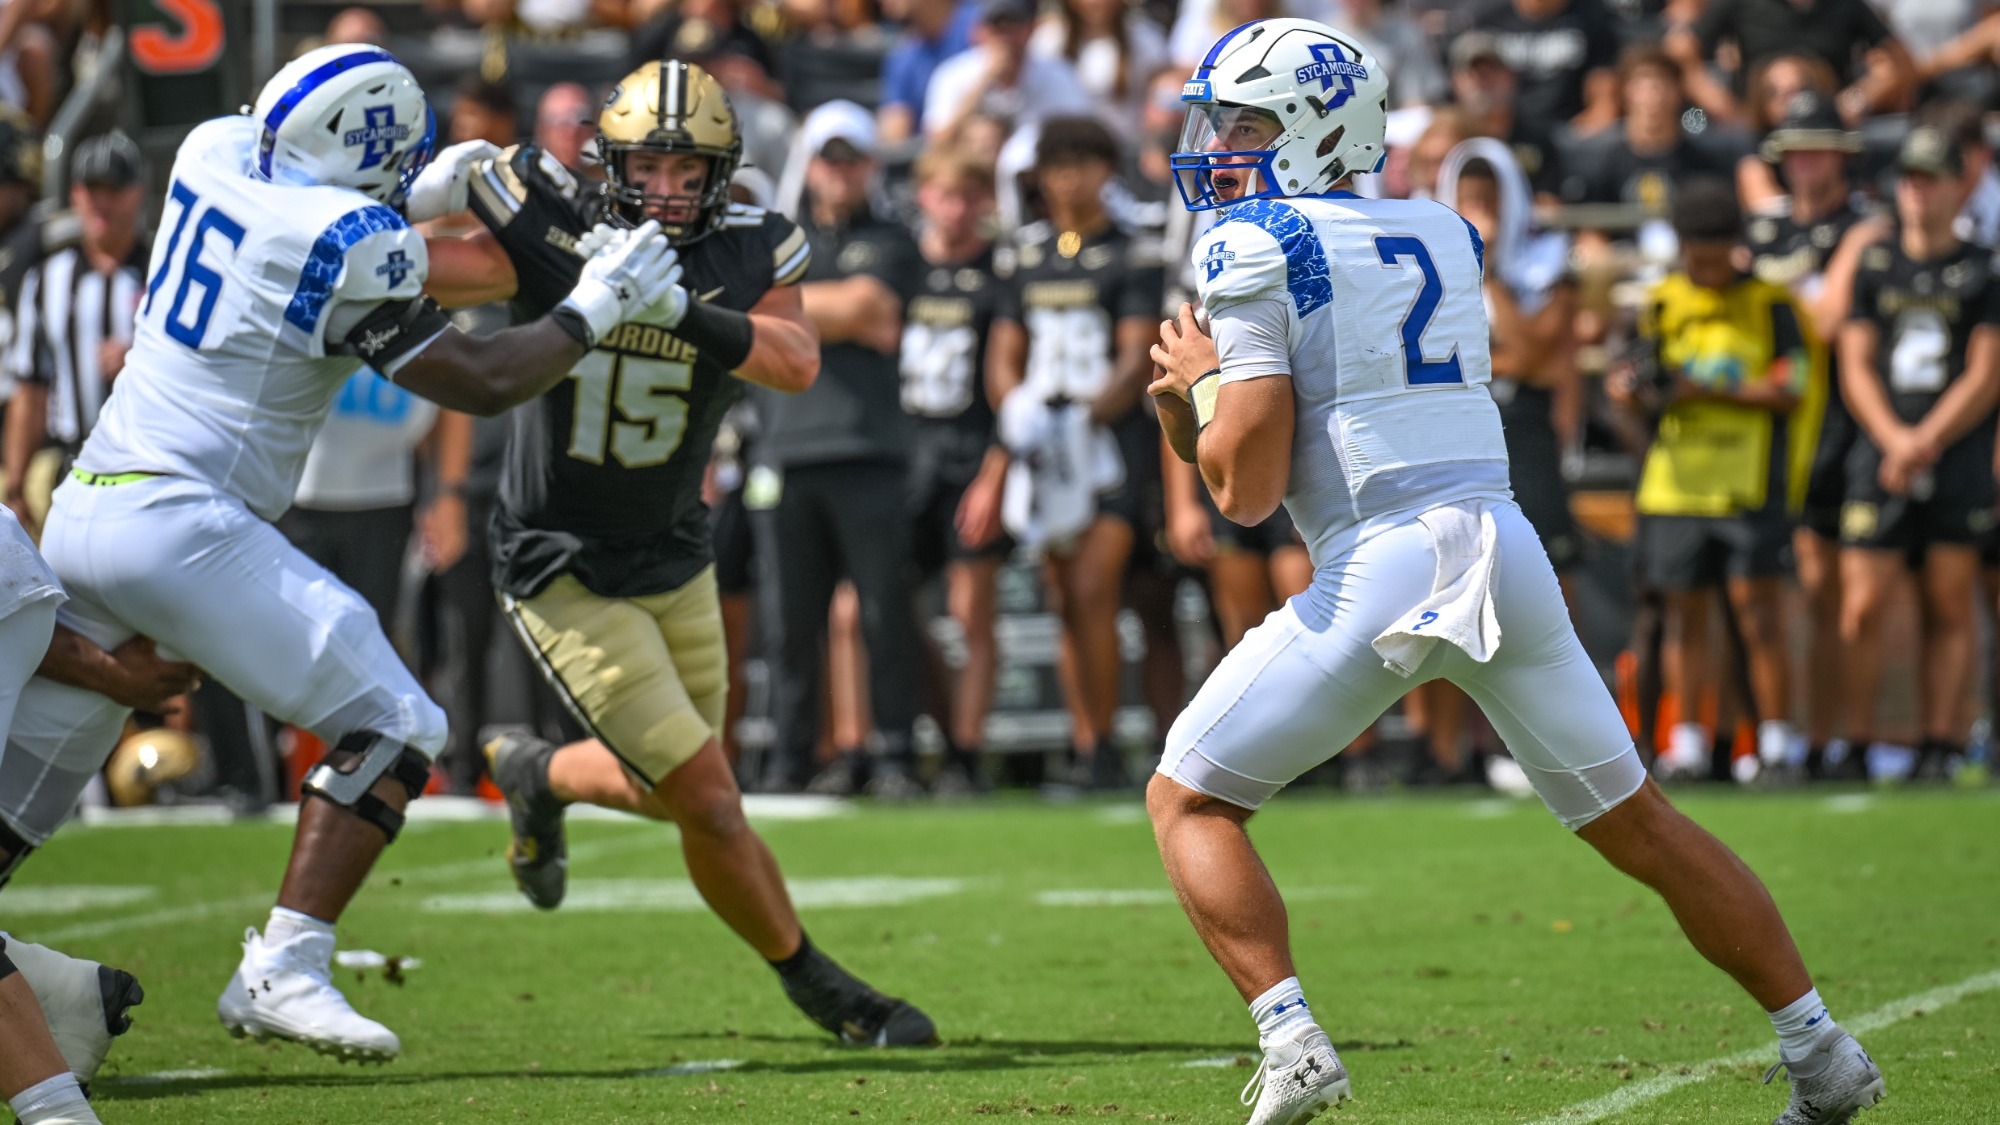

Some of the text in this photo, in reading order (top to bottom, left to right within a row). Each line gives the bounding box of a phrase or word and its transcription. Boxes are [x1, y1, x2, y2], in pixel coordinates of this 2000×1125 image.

[1182, 83, 1206, 96] STATE
[1297, 61, 1367, 84] SYCAMORES
[345, 124, 409, 146] SYCAMORES
[144, 179, 247, 350] 76
[1371, 233, 1468, 389] 2
[567, 349, 695, 469] 15
